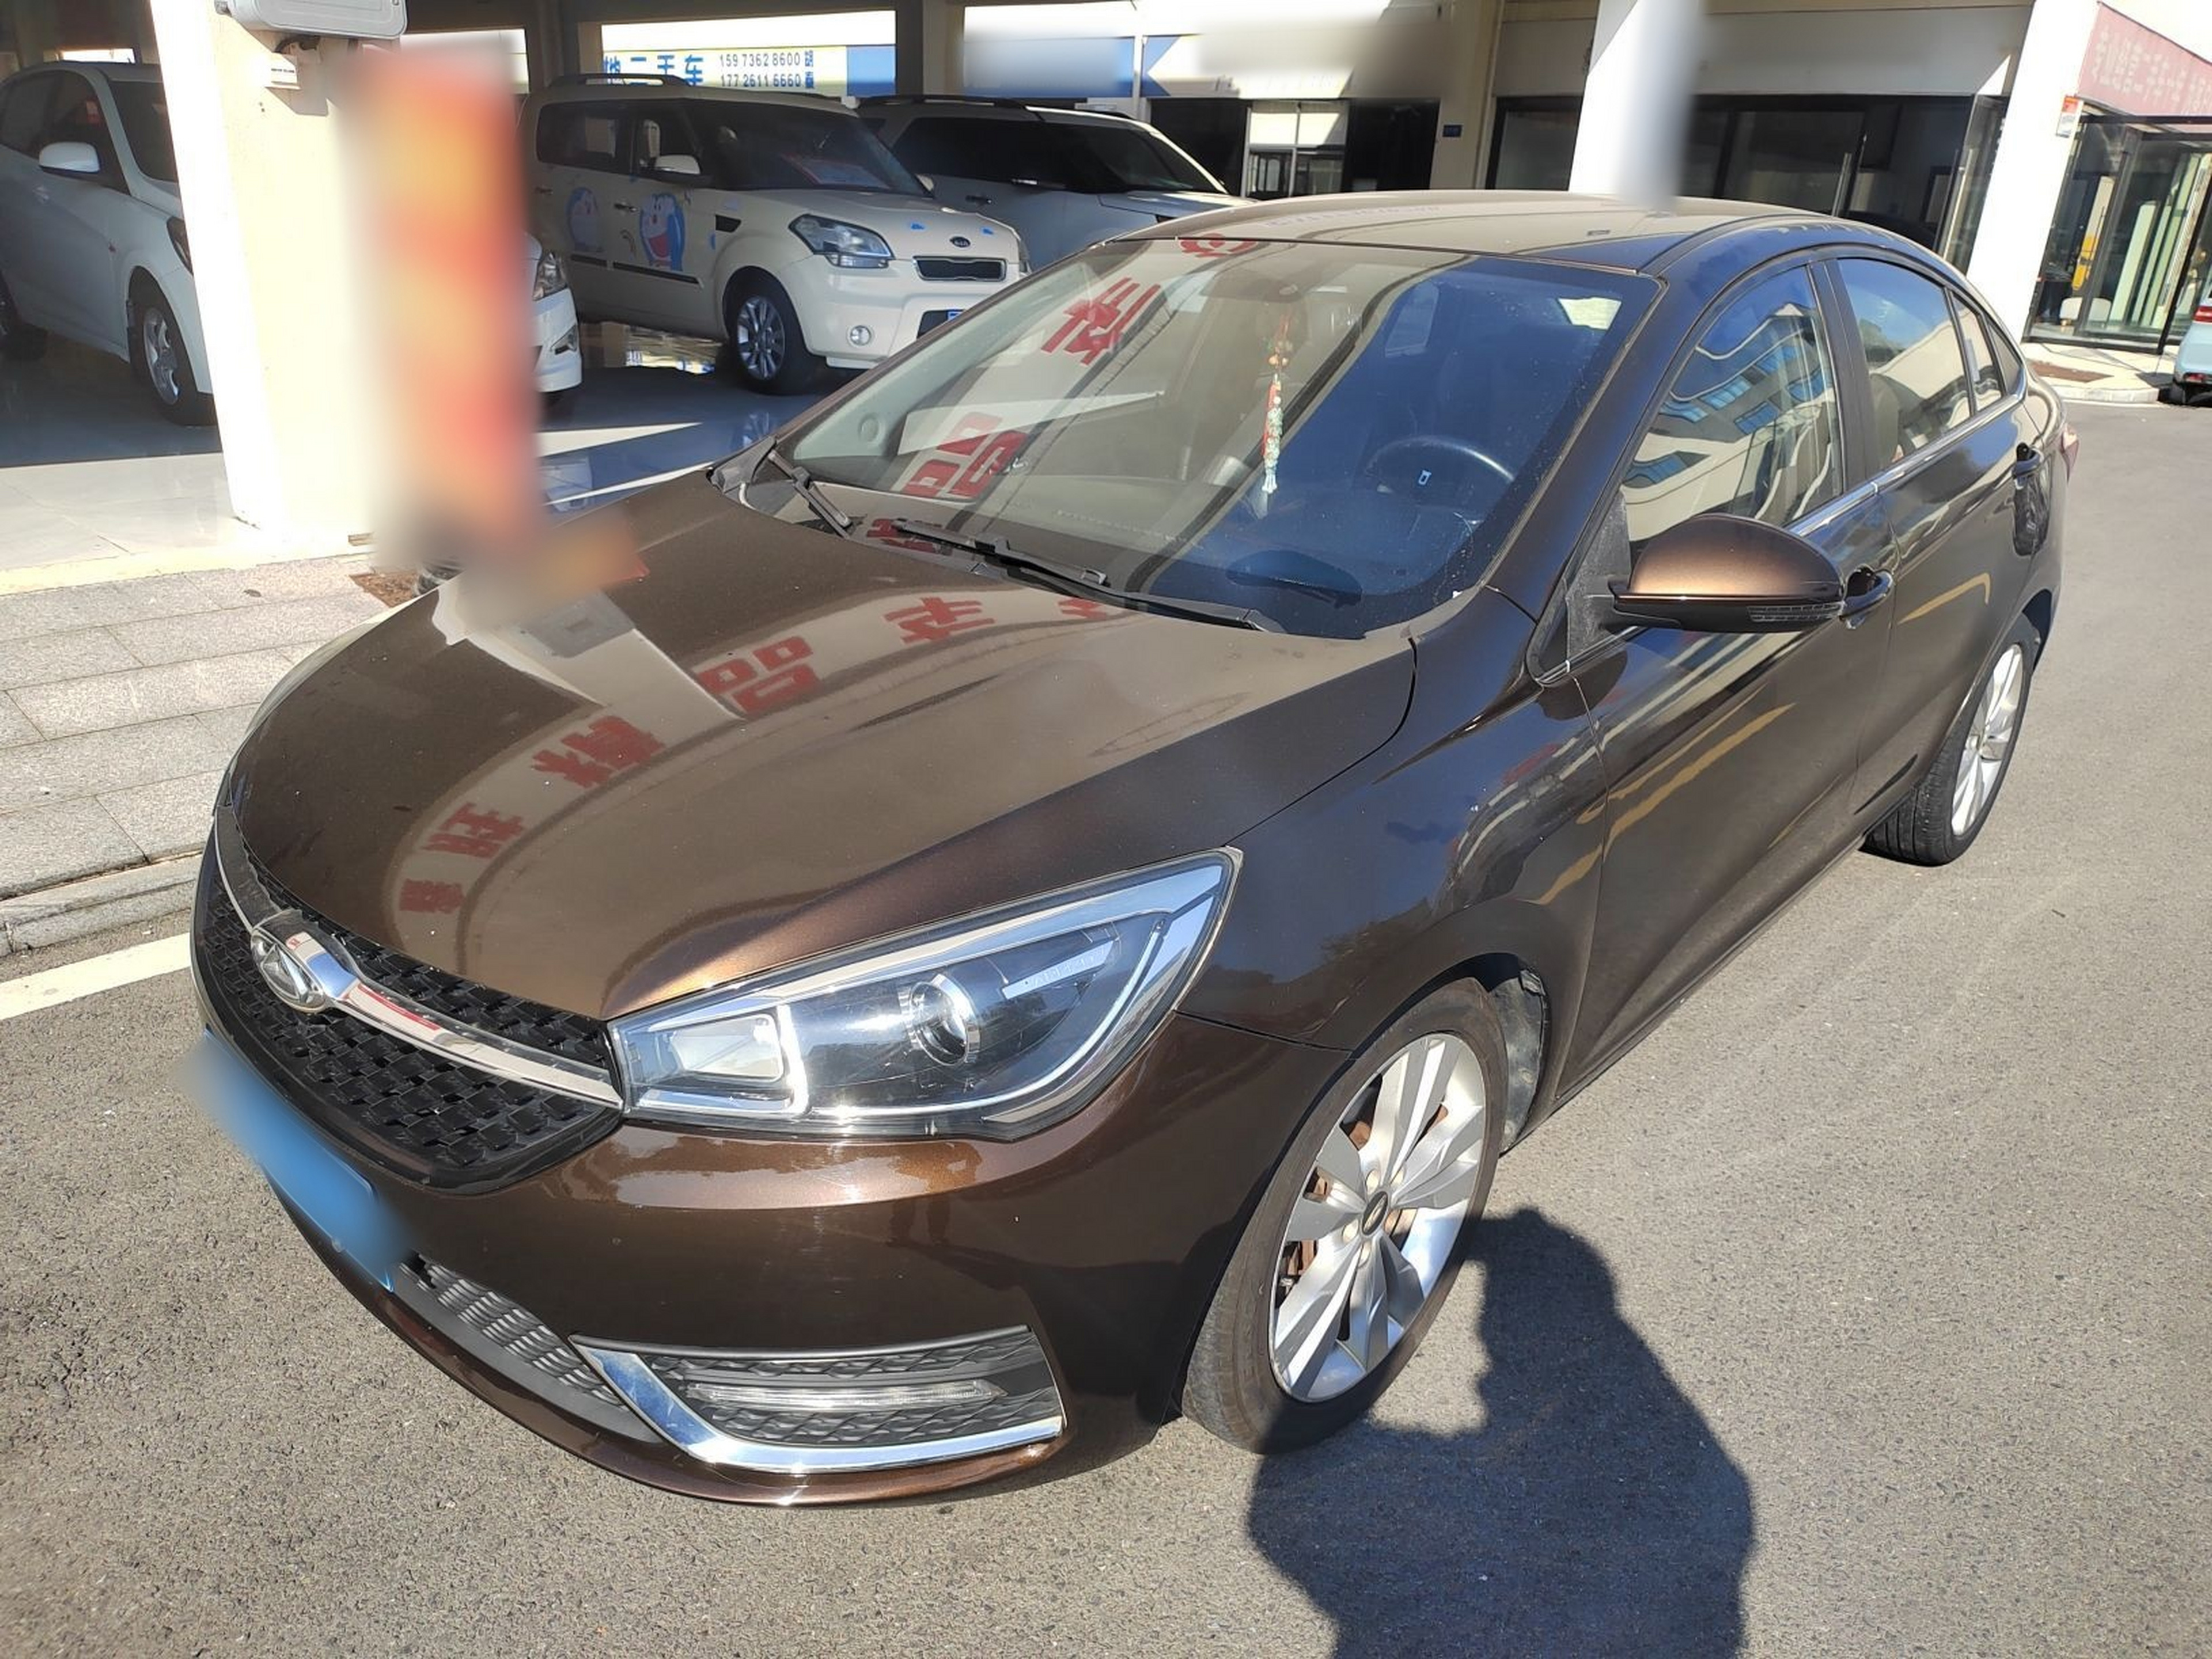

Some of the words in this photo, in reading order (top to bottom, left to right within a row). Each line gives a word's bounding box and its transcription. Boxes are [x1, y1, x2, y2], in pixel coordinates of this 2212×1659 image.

[719, 54, 738, 67] 159
[741, 53, 769, 67] 7362
[772, 52, 801, 66] 8600
[721, 73, 739, 87] 177
[743, 73, 769, 87] 2611
[772, 73, 801, 87] 6660
